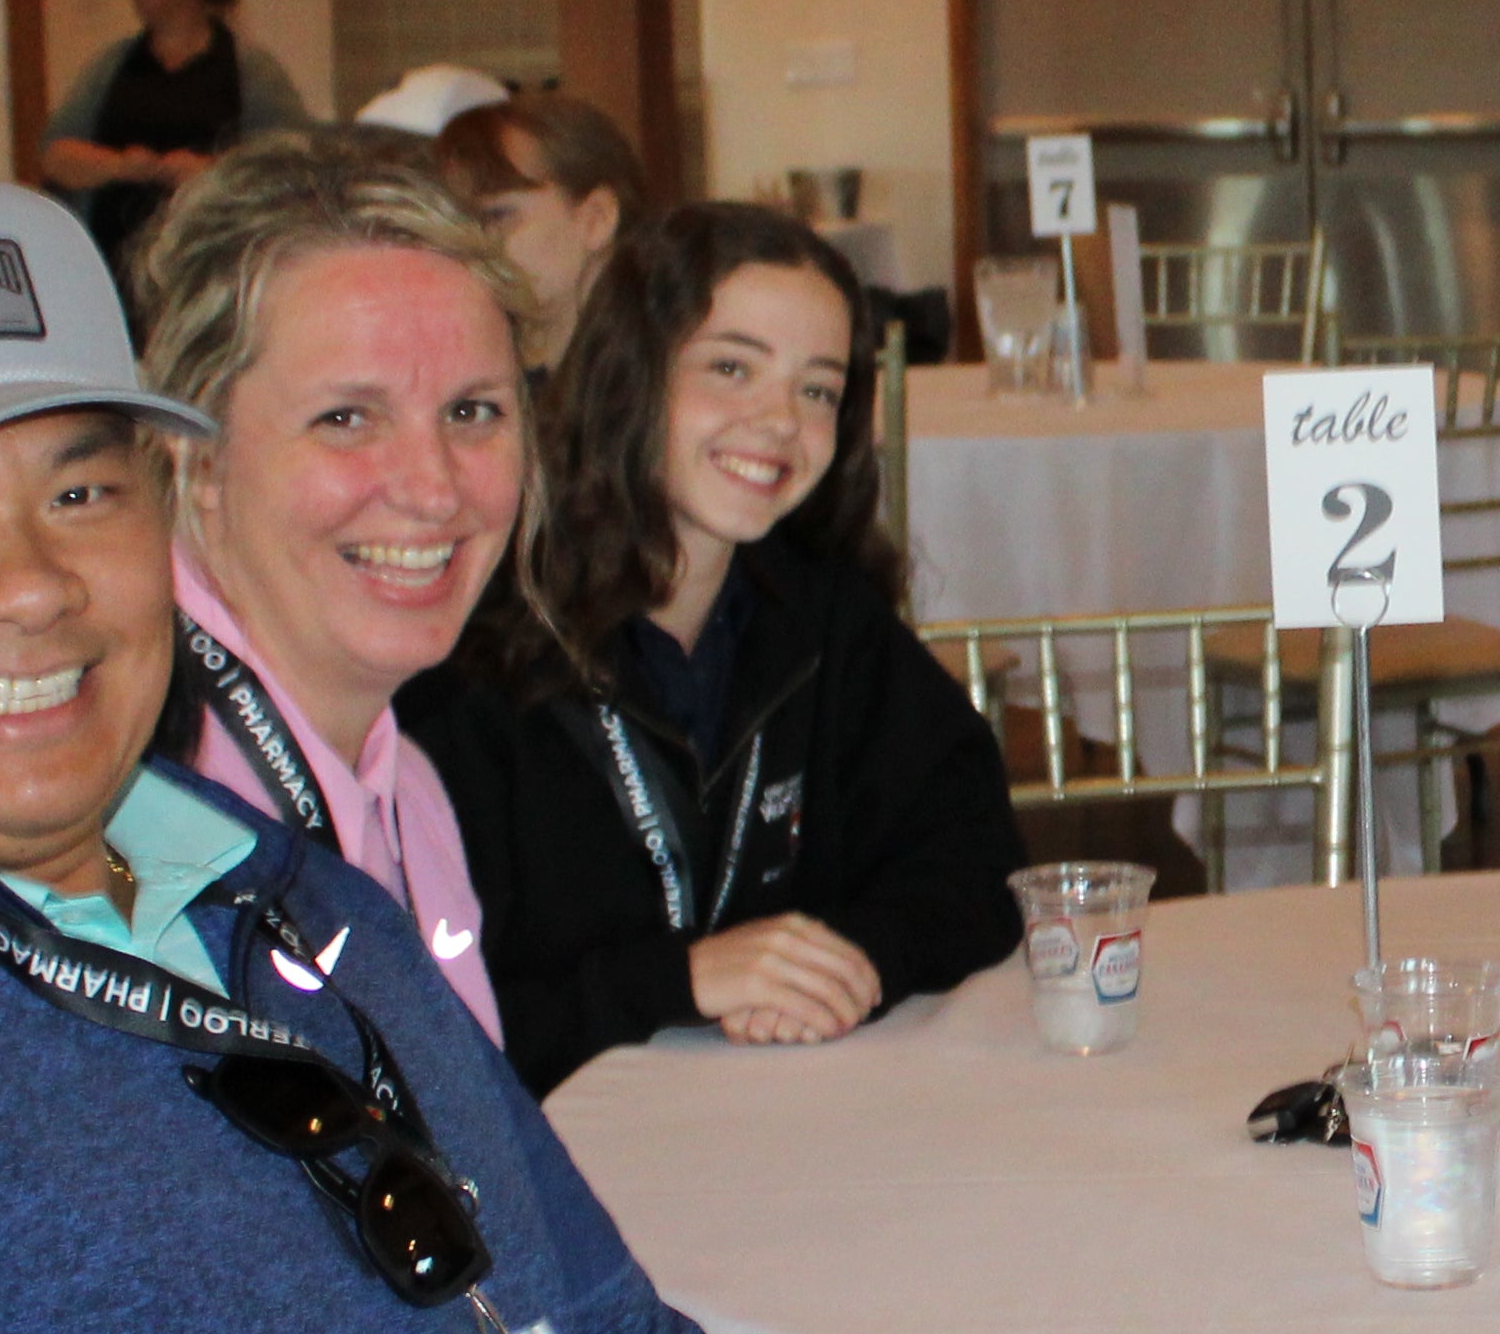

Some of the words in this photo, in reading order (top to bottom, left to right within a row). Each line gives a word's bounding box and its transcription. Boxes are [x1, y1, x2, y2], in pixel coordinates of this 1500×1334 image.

[1049, 179, 1075, 220] 7
[1290, 390, 1408, 447] table
[1321, 482, 1398, 588] 2
[228, 682, 324, 830] PHARMACY
[645, 828, 683, 931] ATERLOO
[179, 997, 312, 1050] TERLOO
